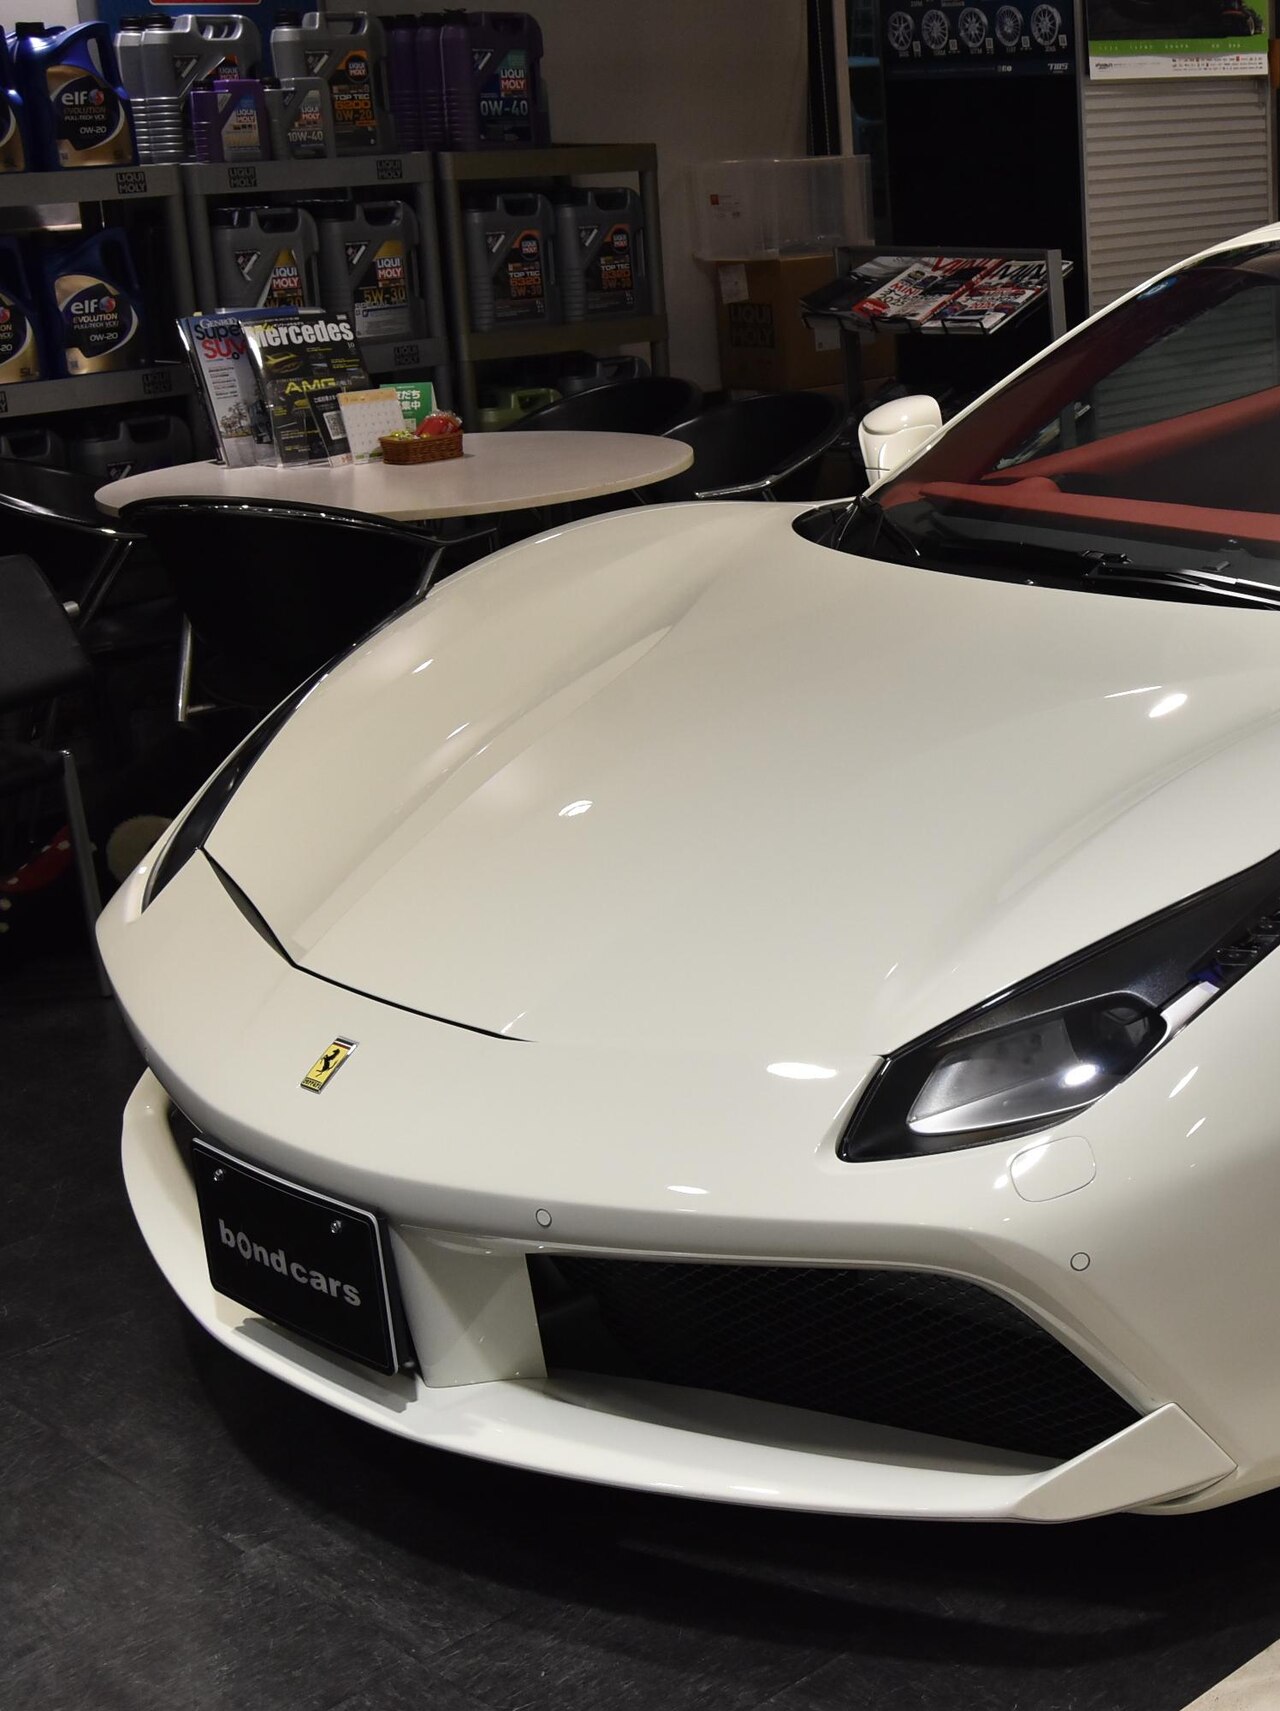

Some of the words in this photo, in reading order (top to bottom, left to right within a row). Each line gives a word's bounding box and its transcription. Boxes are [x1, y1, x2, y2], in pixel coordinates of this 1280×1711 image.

[501, 69, 524, 79] LIQUI
[501, 79, 526, 89] MOLY
[61, 91, 88, 106] elf
[480, 99, 529, 116] 0W-40
[80, 126, 107, 135] 0W-20
[288, 131, 324, 143] 10W-40
[118, 172, 145, 182] LIQUI
[230, 177, 257, 188] MOLY
[119, 181, 147, 193] MOLY
[377, 258, 401, 268] LIQUI
[273, 266, 298, 277] LIQUI
[378, 267, 402, 278] MOLY
[273, 277, 299, 288] MOLY
[364, 287, 406, 303] 5W-30
[890, 282, 921, 297] MINI
[71, 299, 98, 315] elf
[73, 313, 118, 324] EVOLUTION
[90, 332, 119, 342] 0W-20
[195, 324, 241, 341] Supe
[244, 320, 354, 348] Mercedes
[284, 378, 336, 395] AMG
